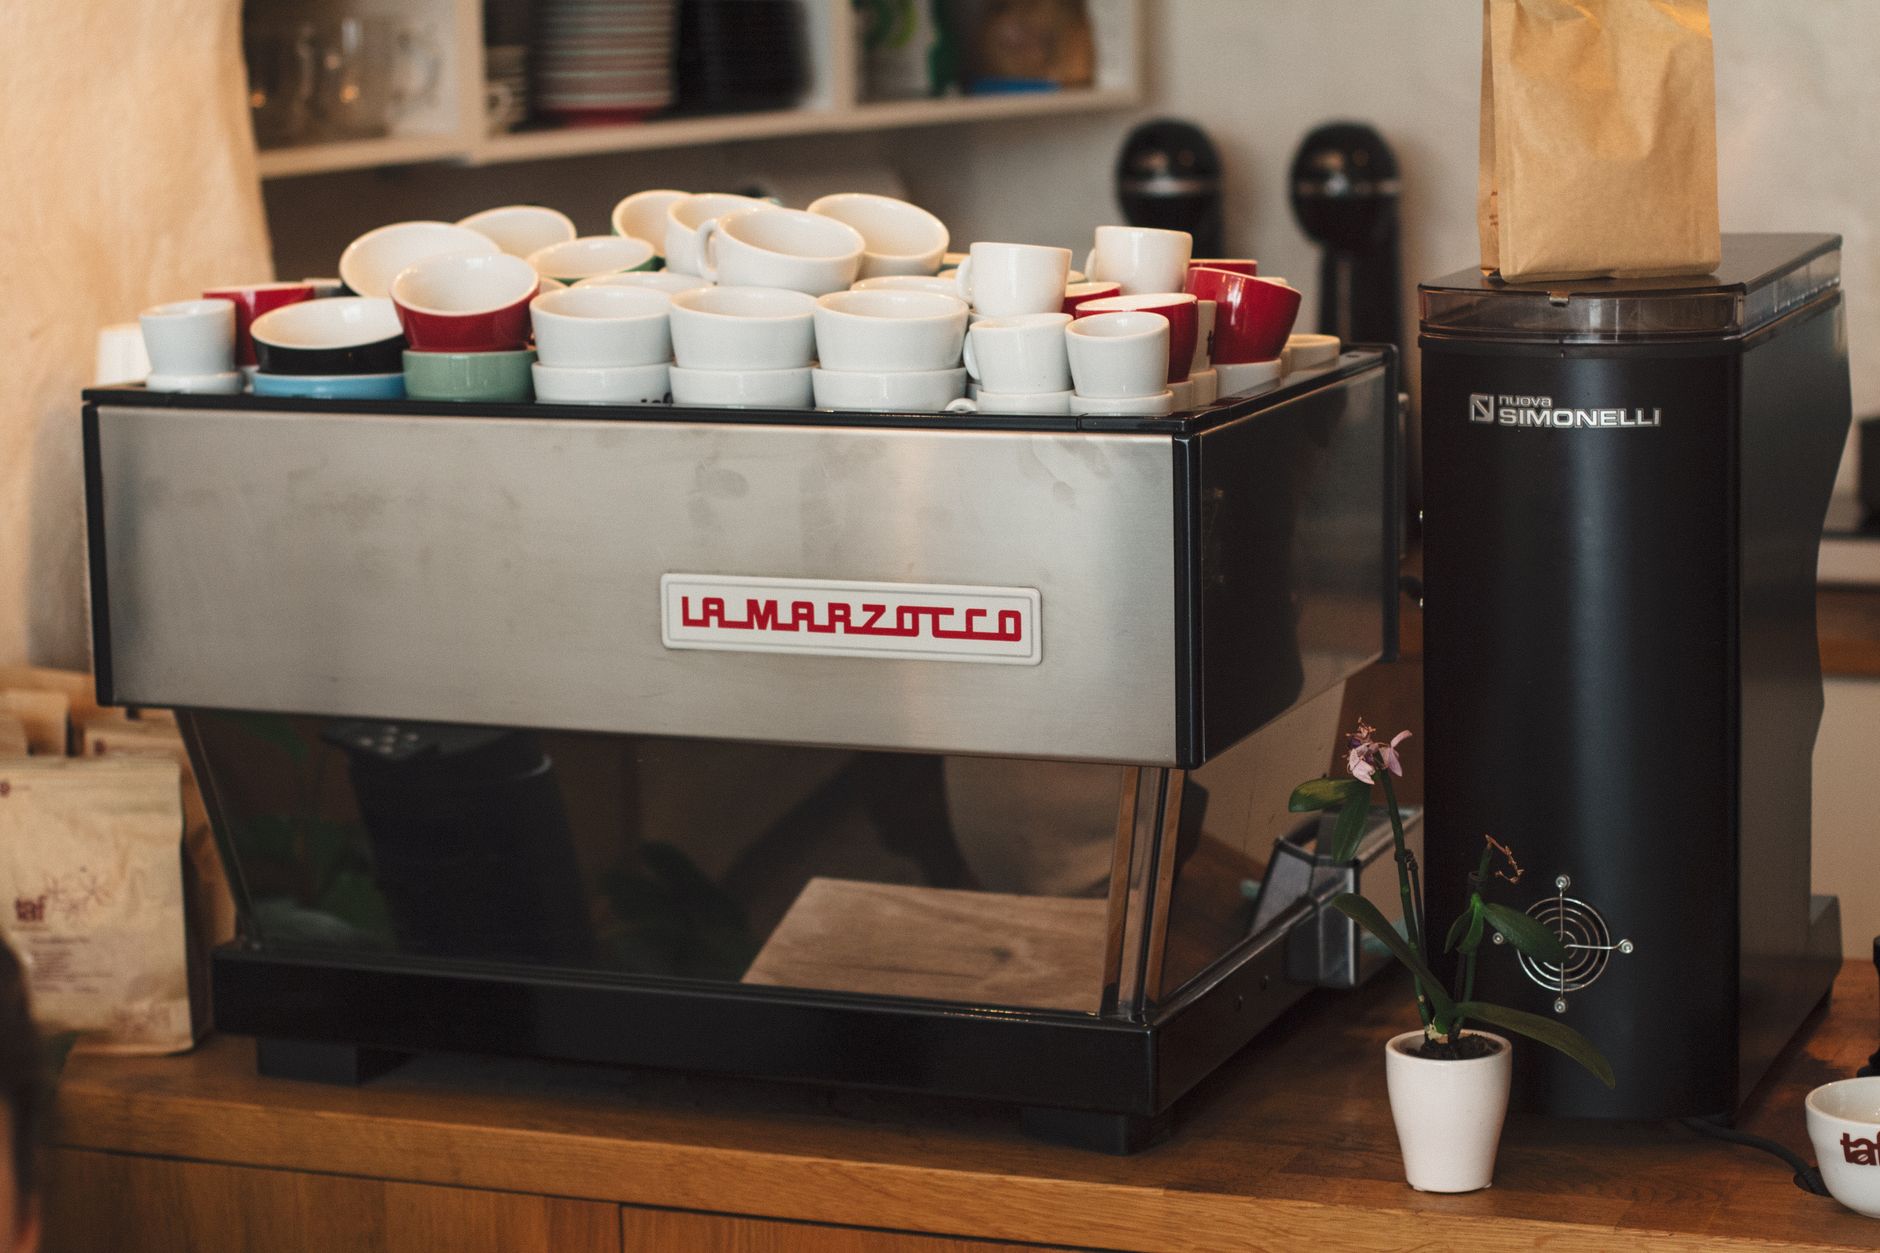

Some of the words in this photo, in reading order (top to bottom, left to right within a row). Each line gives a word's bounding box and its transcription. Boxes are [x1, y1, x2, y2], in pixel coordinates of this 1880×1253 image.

[1499, 395, 1552, 407] nuova
[1499, 408, 1661, 428] SIMONELLI
[681, 596, 725, 629] LA
[746, 599, 1022, 642] MARZOCCO
